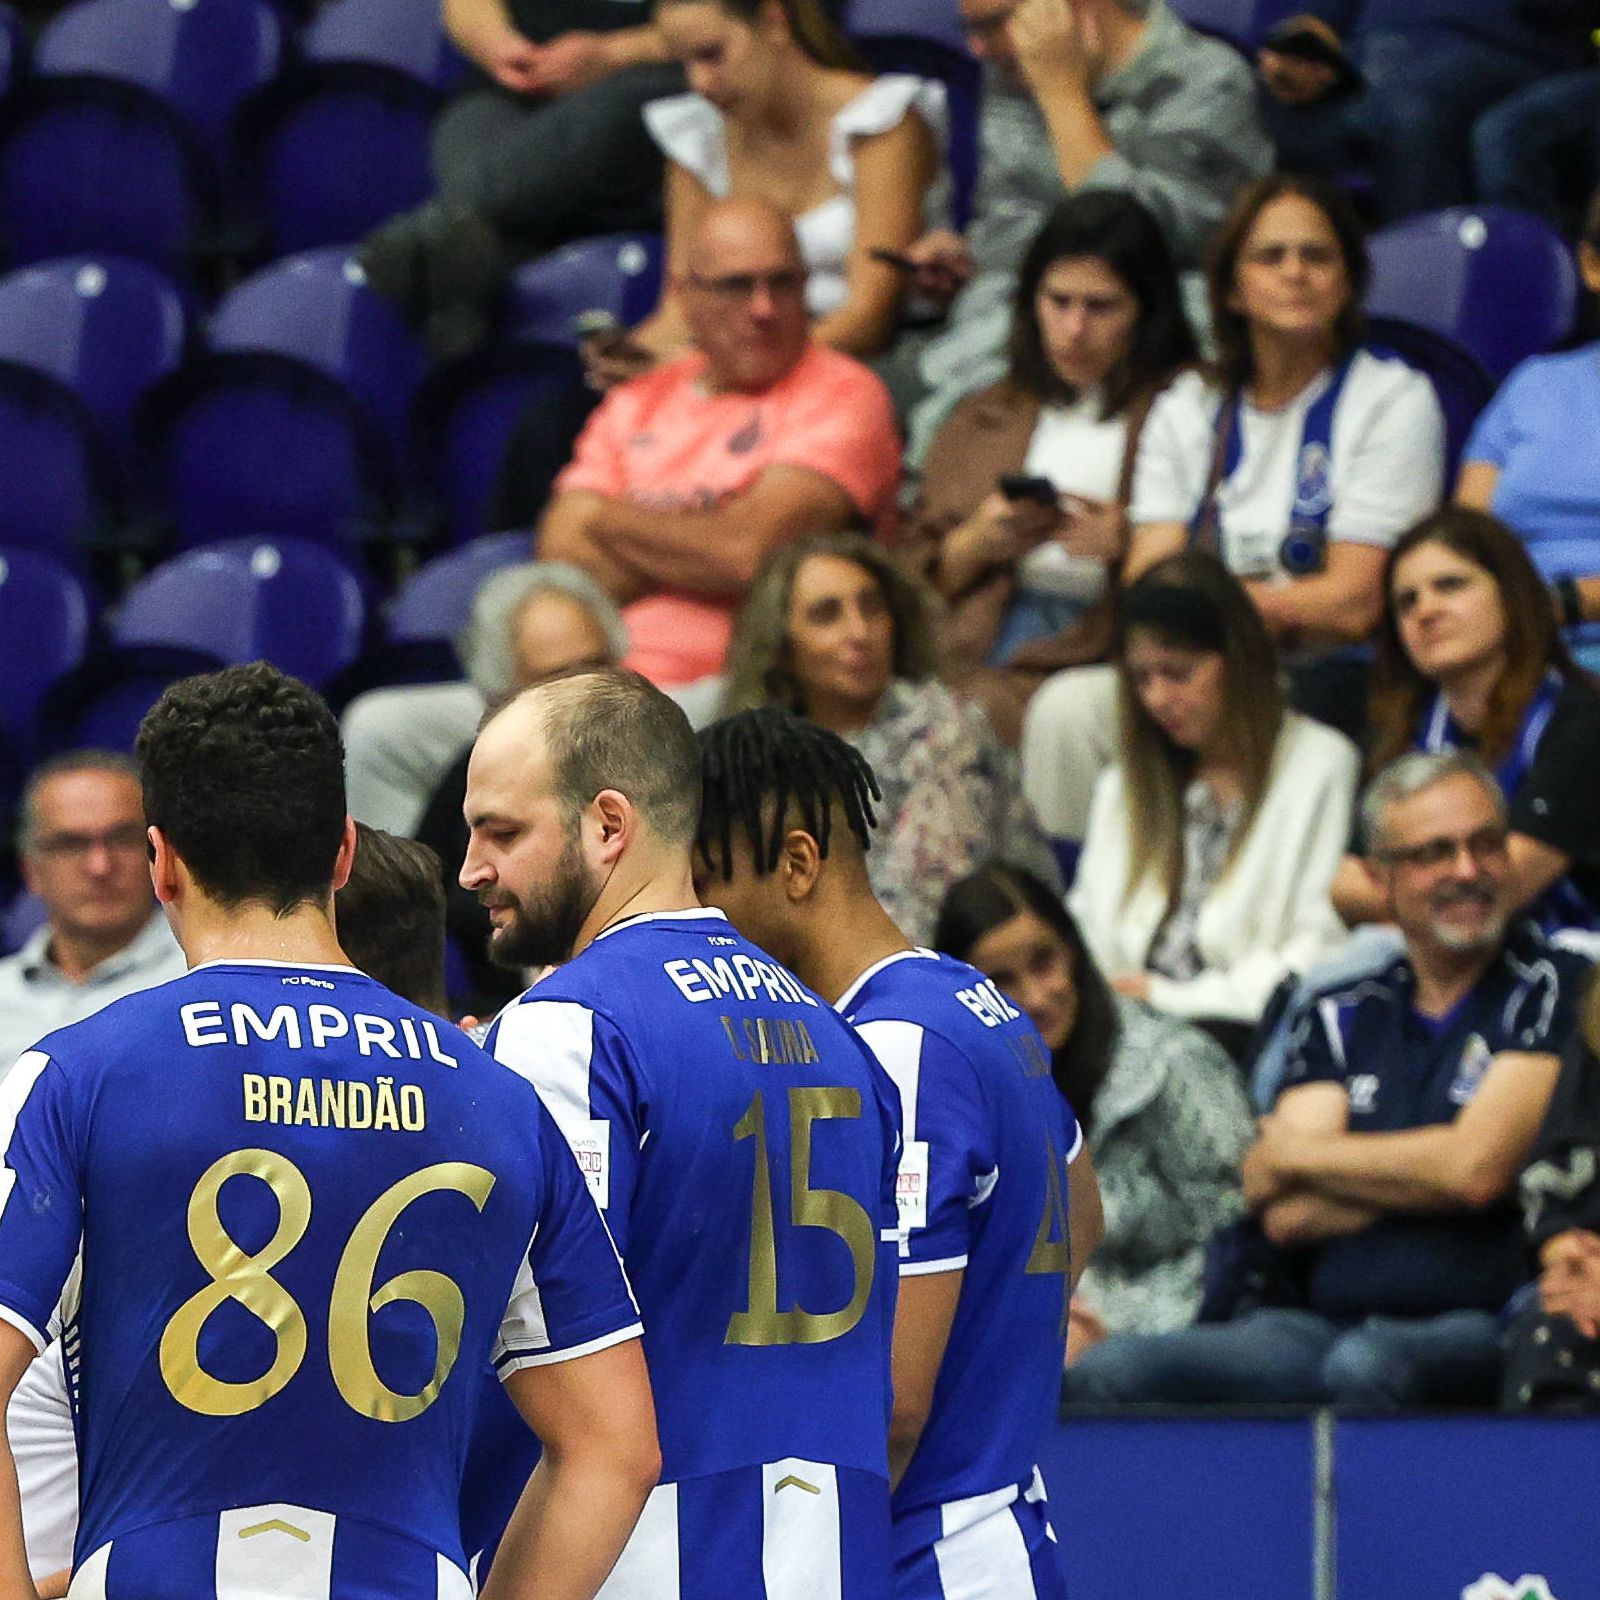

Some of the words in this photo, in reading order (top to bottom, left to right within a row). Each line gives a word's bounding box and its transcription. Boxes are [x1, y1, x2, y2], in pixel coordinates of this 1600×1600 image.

[663, 953, 820, 1008] EMPRIL
[179, 1001, 458, 1069] EMPRIL
[242, 1073, 427, 1132] BRANDÃO
[724, 1086, 876, 1346] 15
[158, 1147, 497, 1423] 86
